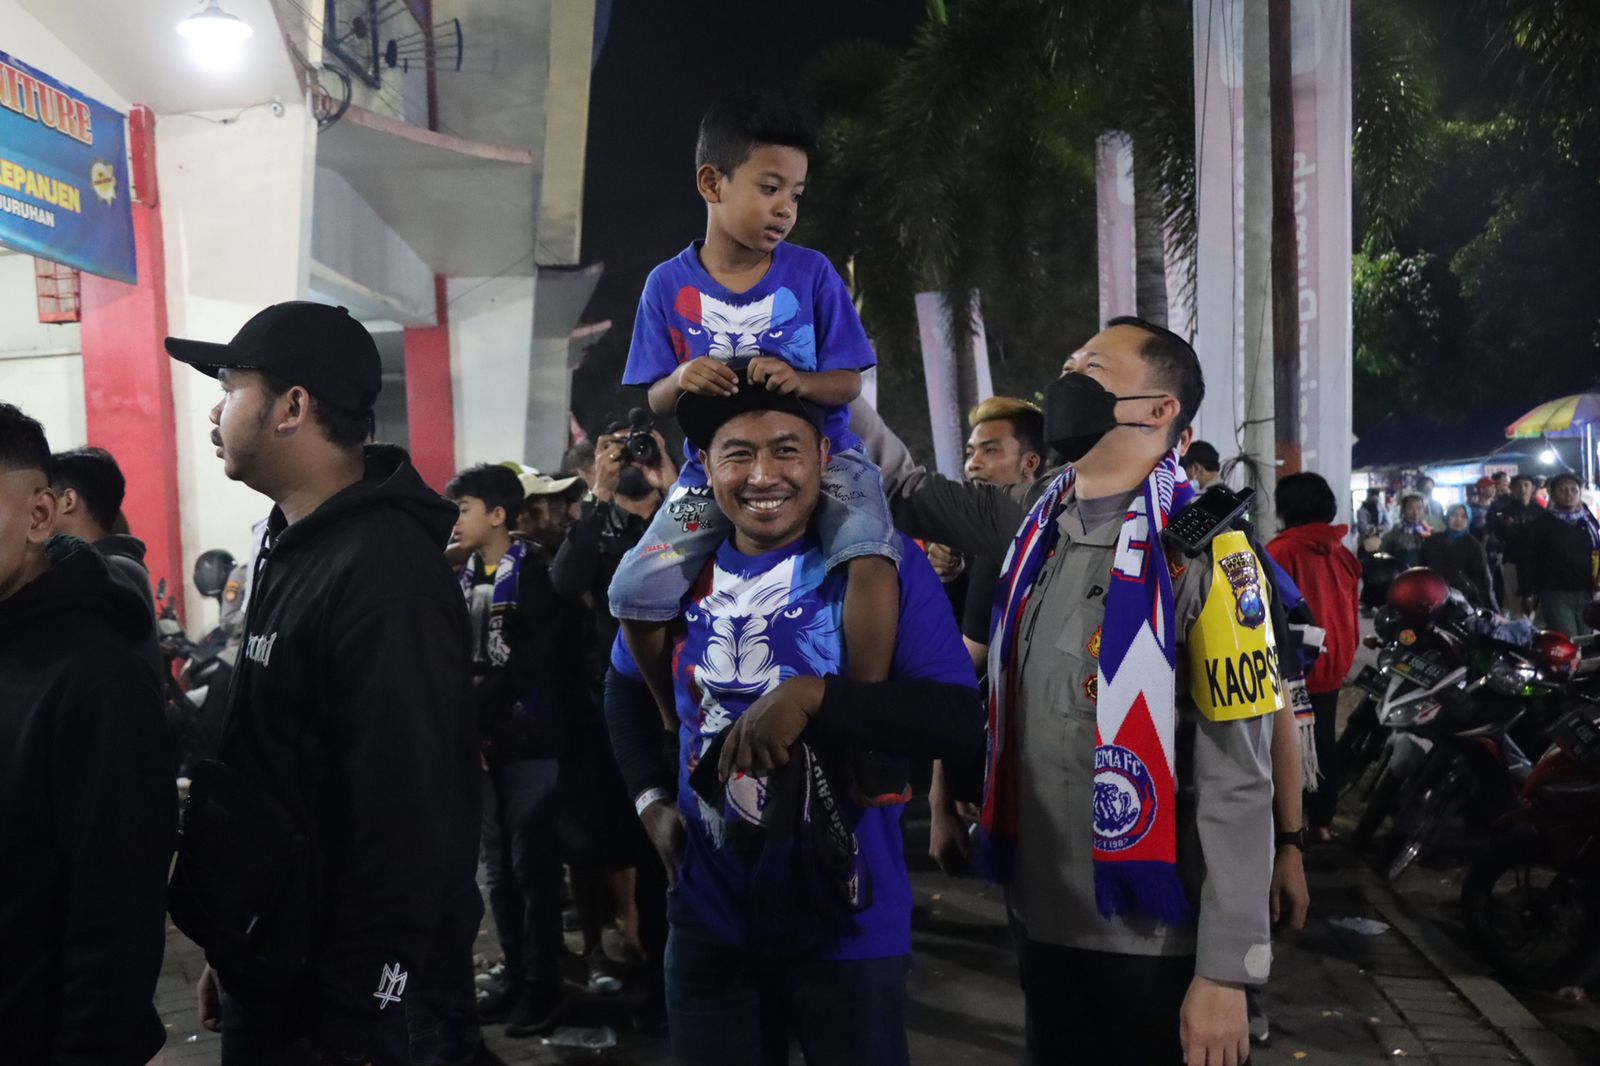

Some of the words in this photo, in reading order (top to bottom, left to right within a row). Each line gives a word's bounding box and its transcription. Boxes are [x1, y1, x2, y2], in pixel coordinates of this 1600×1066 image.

[0, 62, 93, 145] ITURE
[0, 158, 81, 213] EPANJEN
[1124, 752, 1141, 776] FC
